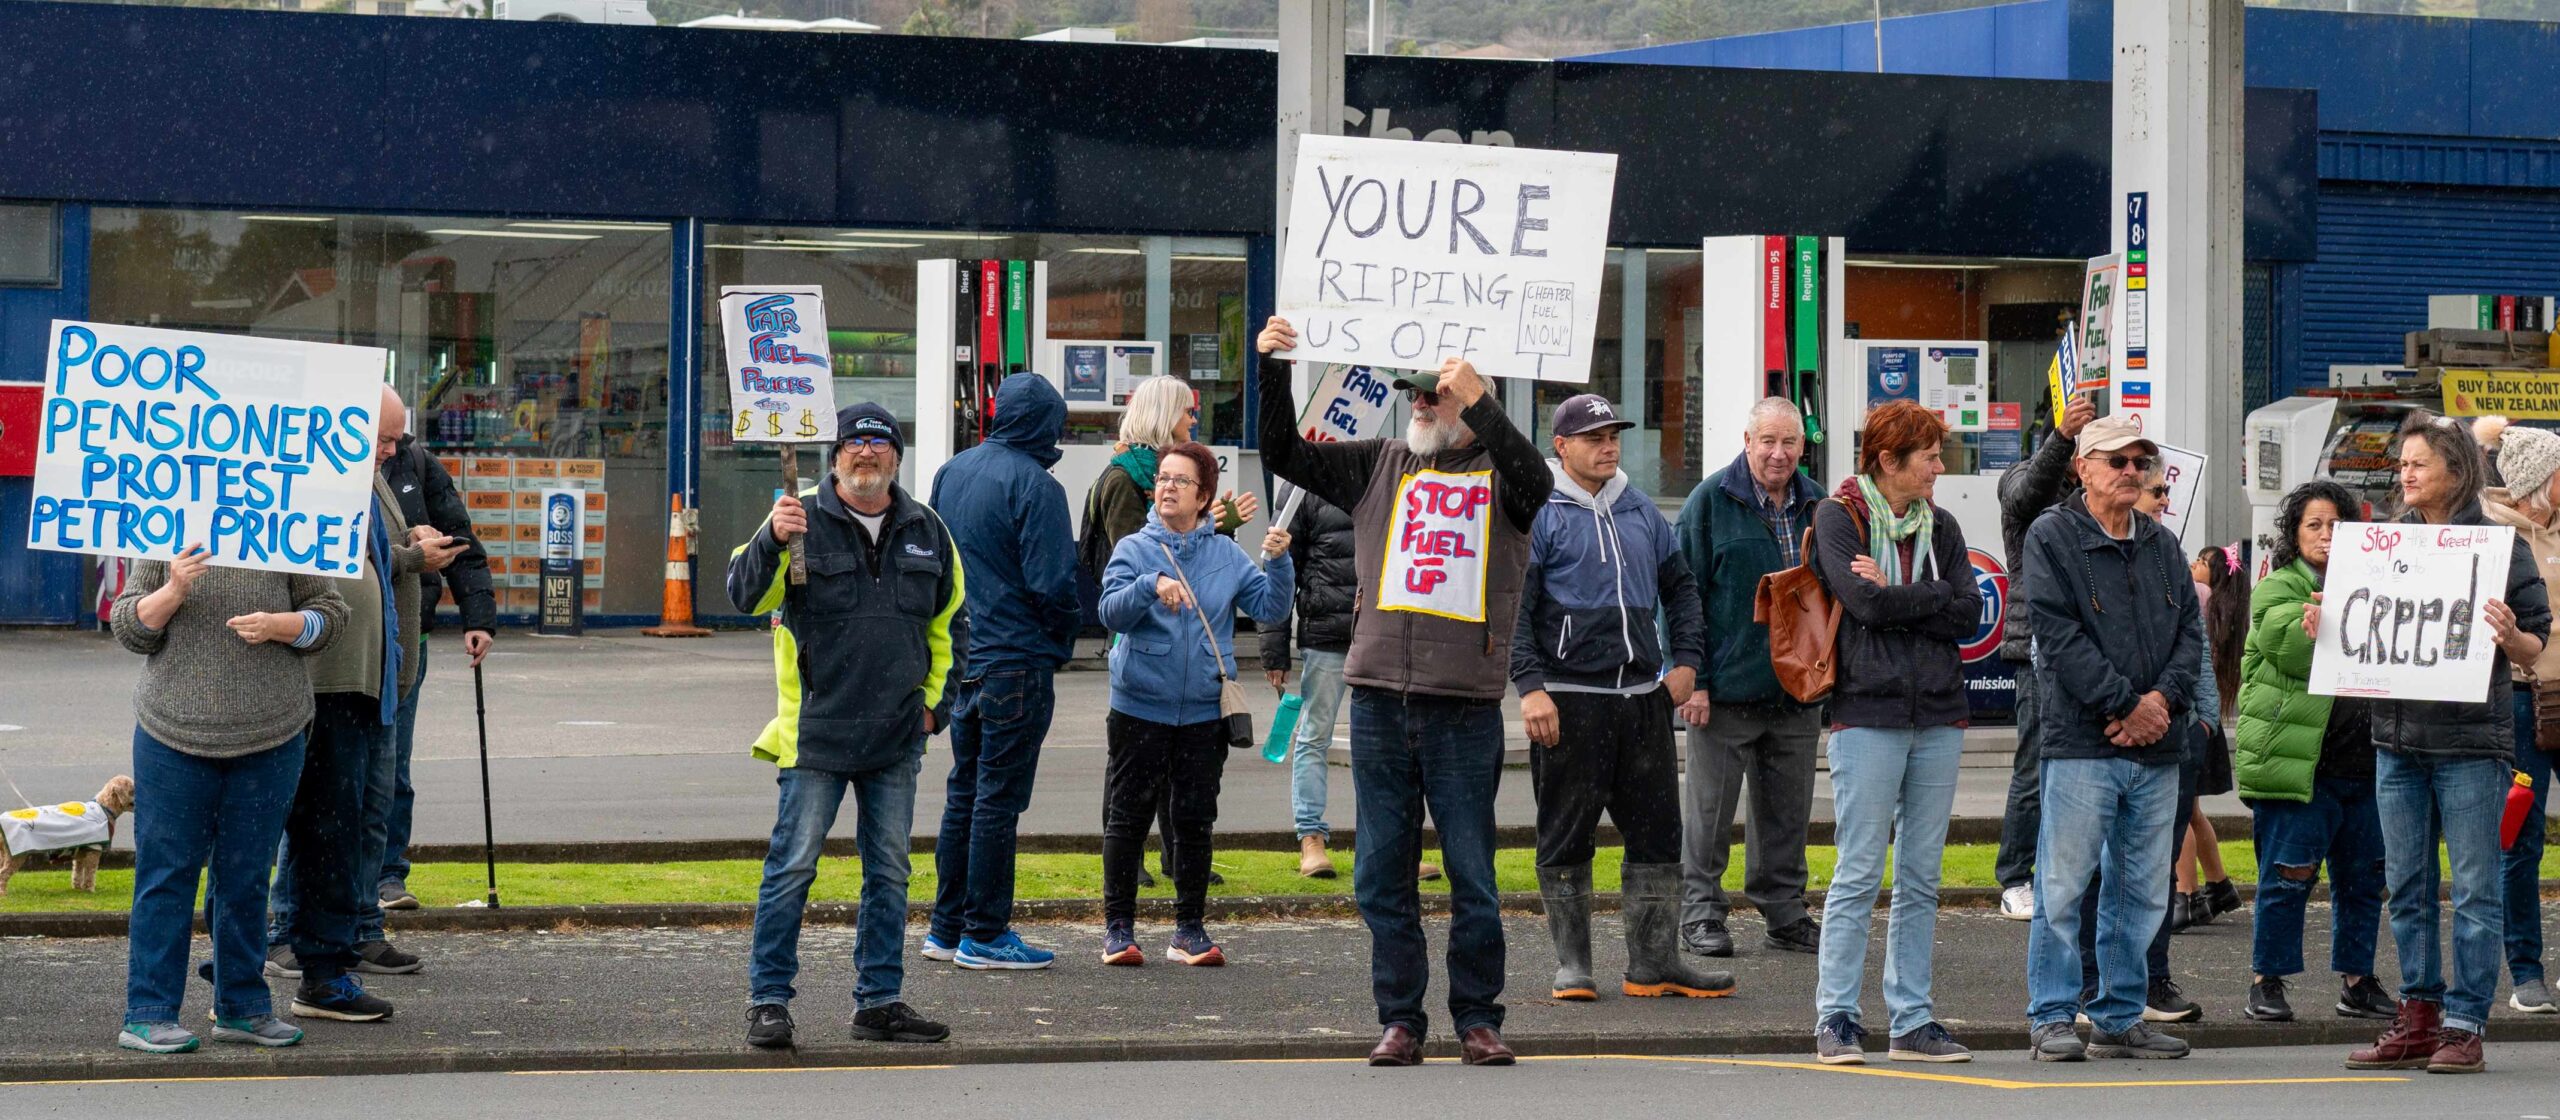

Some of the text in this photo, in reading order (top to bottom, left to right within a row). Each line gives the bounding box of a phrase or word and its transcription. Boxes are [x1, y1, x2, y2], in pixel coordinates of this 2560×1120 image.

[960, 270, 970, 294] Diesel
[986, 270, 996, 317] Premium 95
[1012, 271, 1022, 311] Regular 91
[1317, 259, 1515, 310] RIPPING
[1527, 286, 1572, 301] CHEAPER
[1769, 250, 1780, 308] Premium 95
[1802, 251, 1813, 301] Regular 91
[1532, 304, 1559, 319] FUEL
[1306, 317, 1487, 363] US OFF
[55, 325, 222, 400] POOR
[2336, 373, 2343, 386] 3
[2361, 373, 2368, 386] 4
[1342, 365, 1389, 408] FAIR
[2457, 379, 2559, 395] BUY BACK CONT
[2475, 397, 2560, 412] NEW ZEALAN
[1323, 397, 1358, 436] FUEL
[46, 397, 371, 474] PENSIONERS
[81, 453, 310, 511] PROTEST
[1406, 479, 1491, 521] STOP
[31, 496, 365, 574] PETROL PRICE!
[549, 530, 573, 543] BOSS
[1401, 521, 1476, 558] FUEL
[2361, 525, 2401, 560] Stop
[1406, 567, 1447, 594] UP
[2393, 559, 2408, 573] no
[546, 598, 571, 607] COFFEE
[1970, 676, 2016, 690] mission
